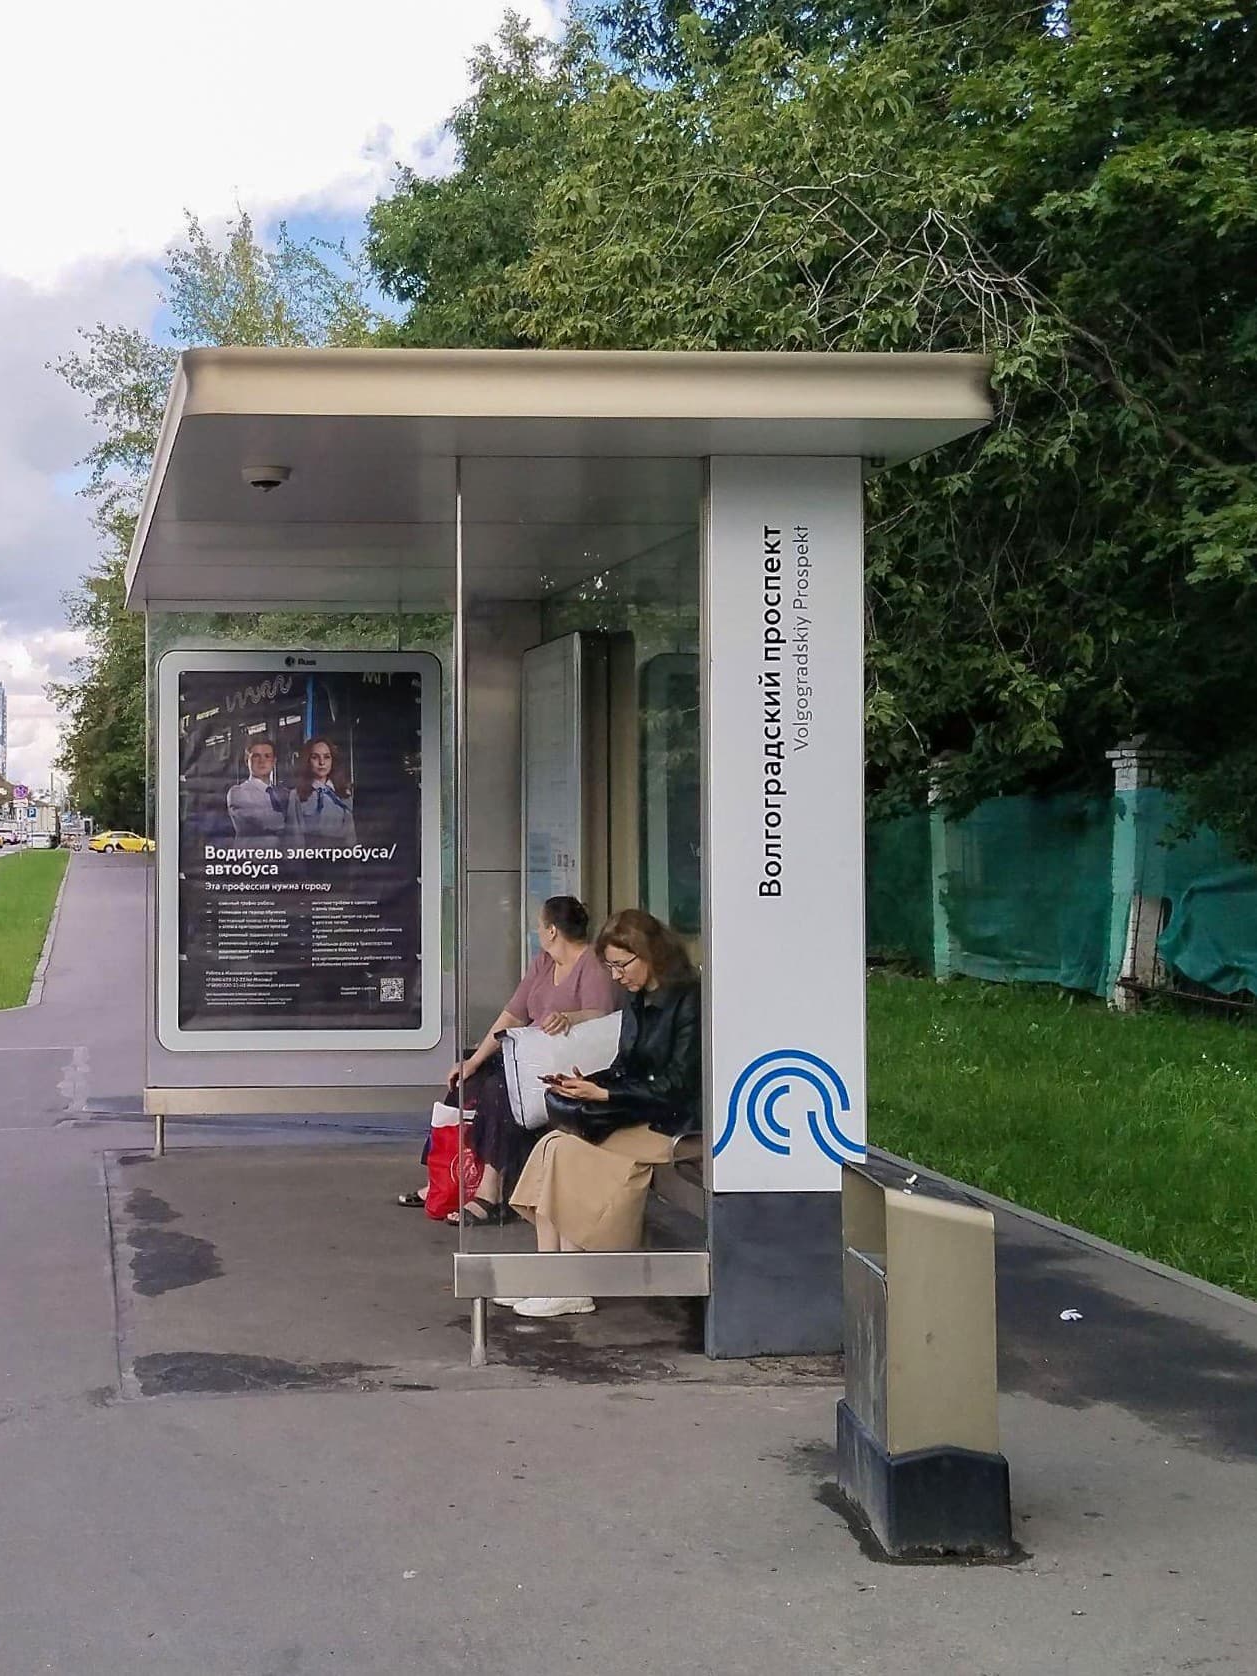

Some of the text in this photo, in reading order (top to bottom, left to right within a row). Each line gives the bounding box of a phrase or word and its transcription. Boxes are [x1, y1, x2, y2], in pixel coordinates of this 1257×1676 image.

[792, 525, 813, 752] Volgogradskiy Prospekt
[758, 525, 787, 898] Волгоградский проспект
[204, 843, 398, 862] Водитель электробуса/
[205, 861, 279, 879] автобуса
[204, 882, 332, 893] Эта профессия нужна городу
